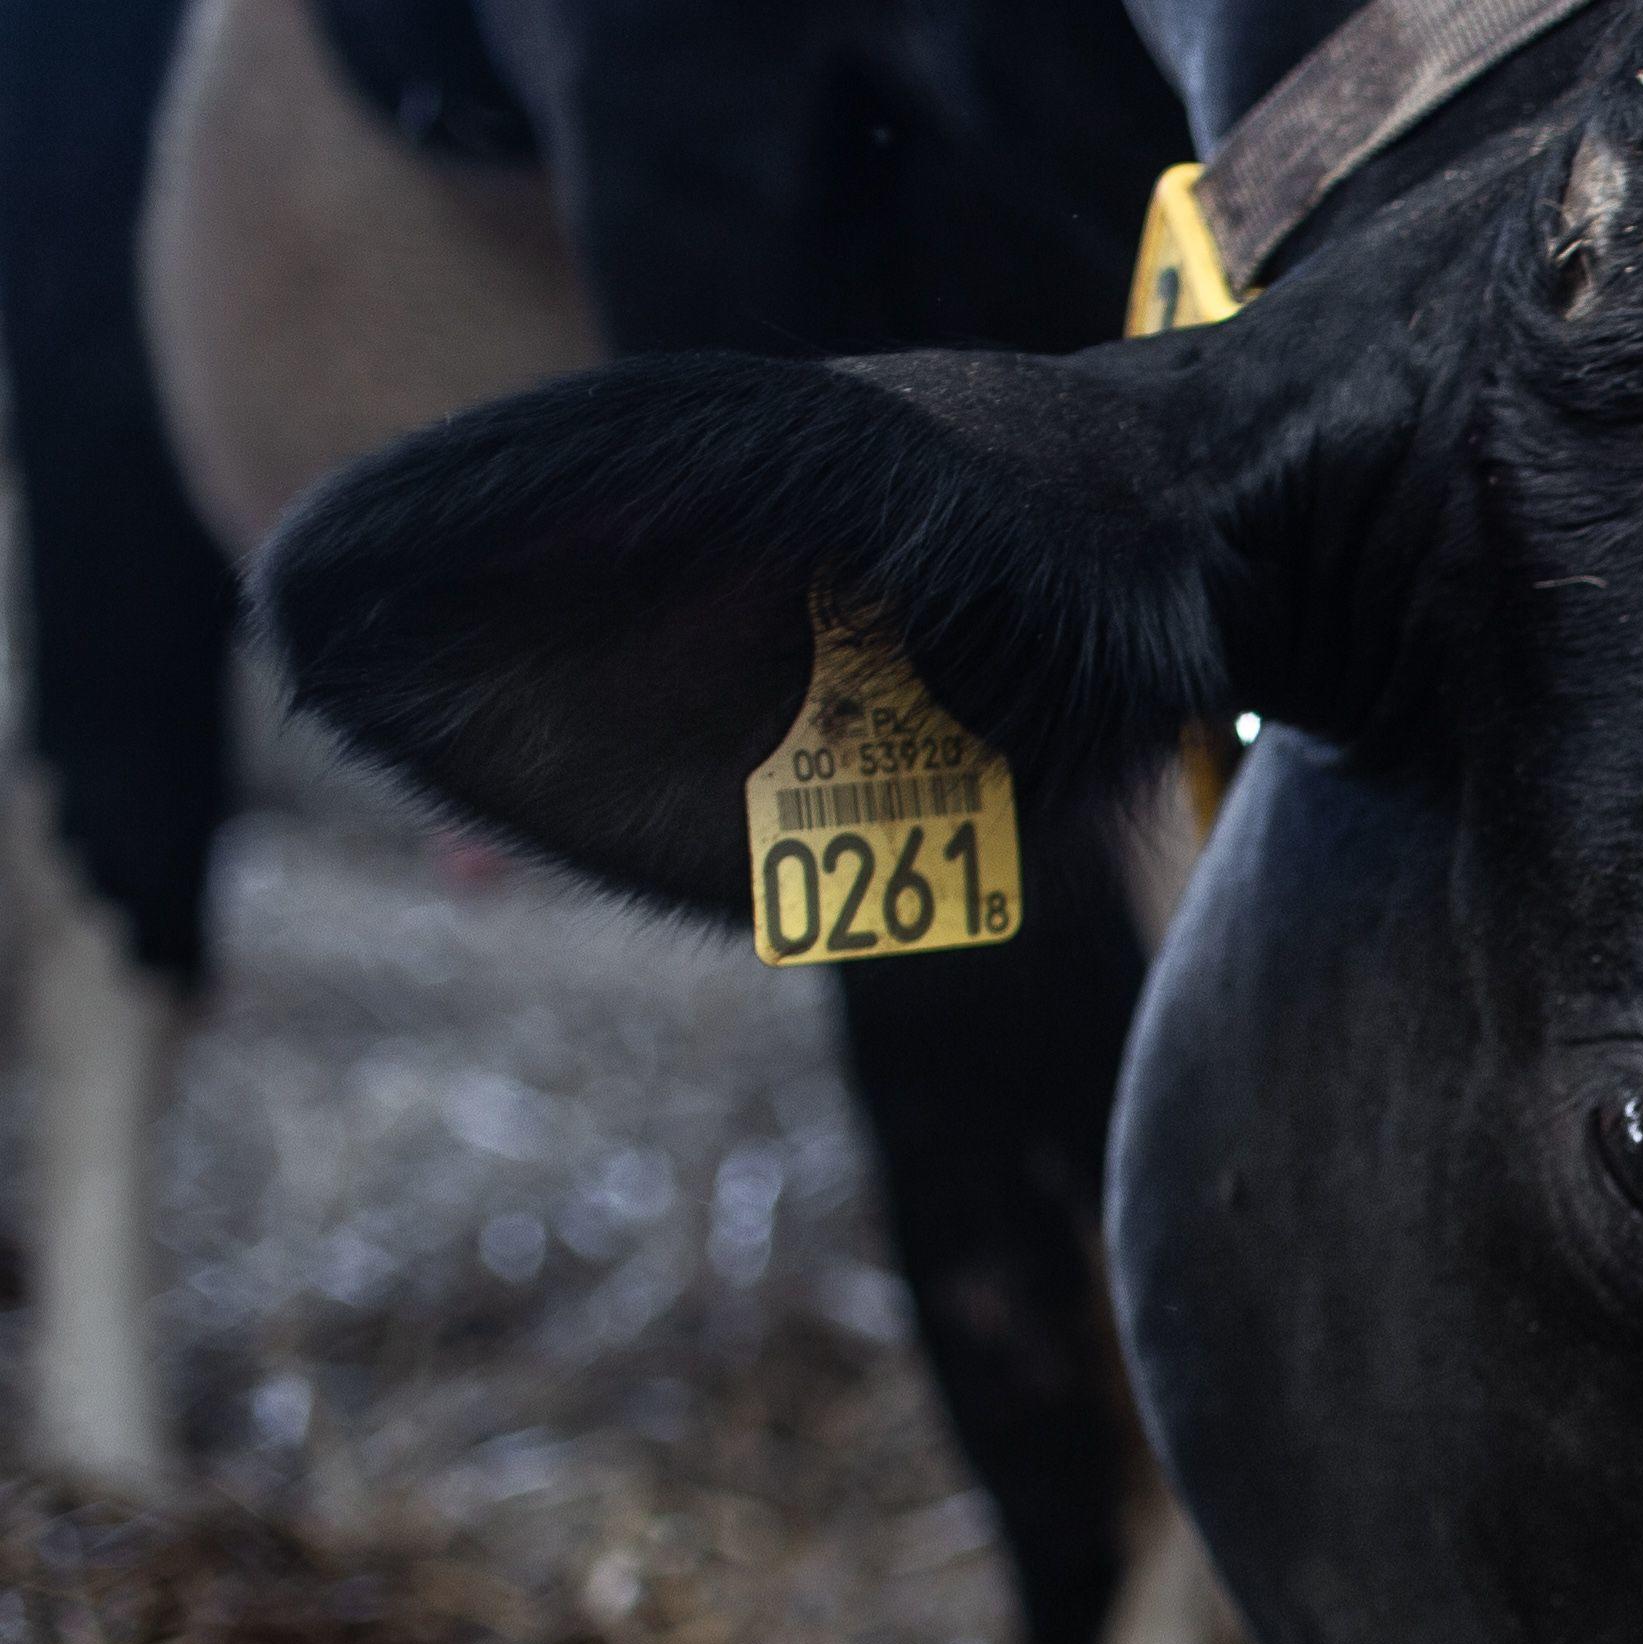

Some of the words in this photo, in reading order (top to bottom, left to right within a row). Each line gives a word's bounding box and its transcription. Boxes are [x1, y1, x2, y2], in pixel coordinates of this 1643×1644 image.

[792, 748, 836, 782] 00
[763, 820, 981, 954] 0261
[985, 892, 1009, 933] 8
